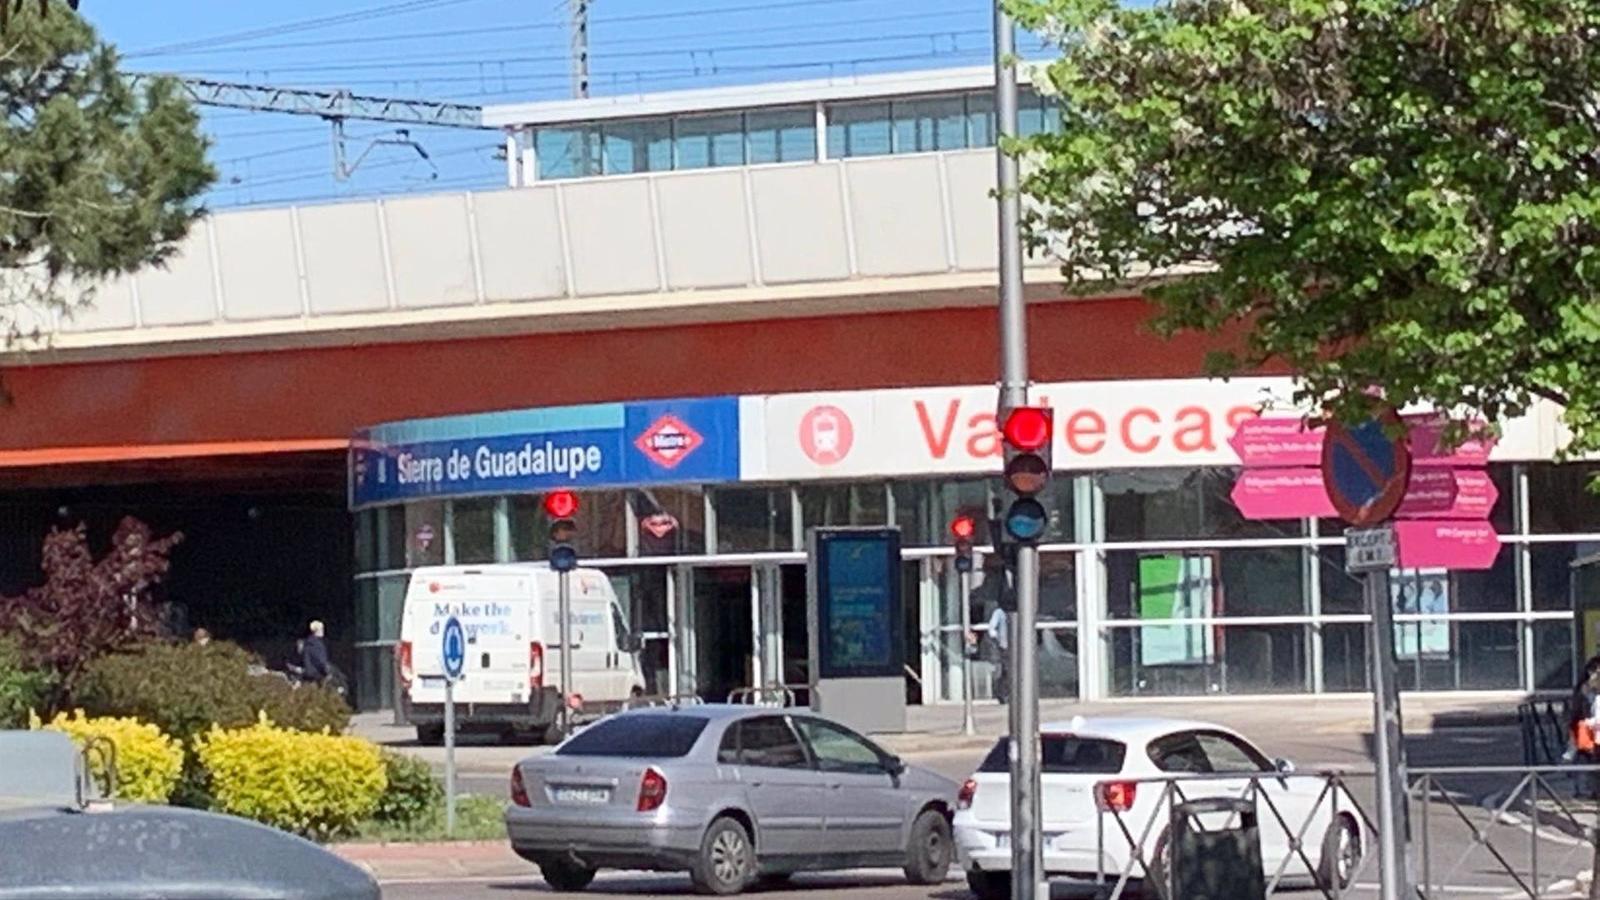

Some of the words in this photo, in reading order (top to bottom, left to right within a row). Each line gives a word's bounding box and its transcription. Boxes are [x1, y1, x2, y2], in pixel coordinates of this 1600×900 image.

[914, 396, 1258, 460] Vaeca
[398, 453, 443, 485] Sierra
[447, 448, 471, 481] de
[475, 441, 602, 479] Guadalupe
[433, 602, 481, 617] Make
[484, 602, 512, 616] the
